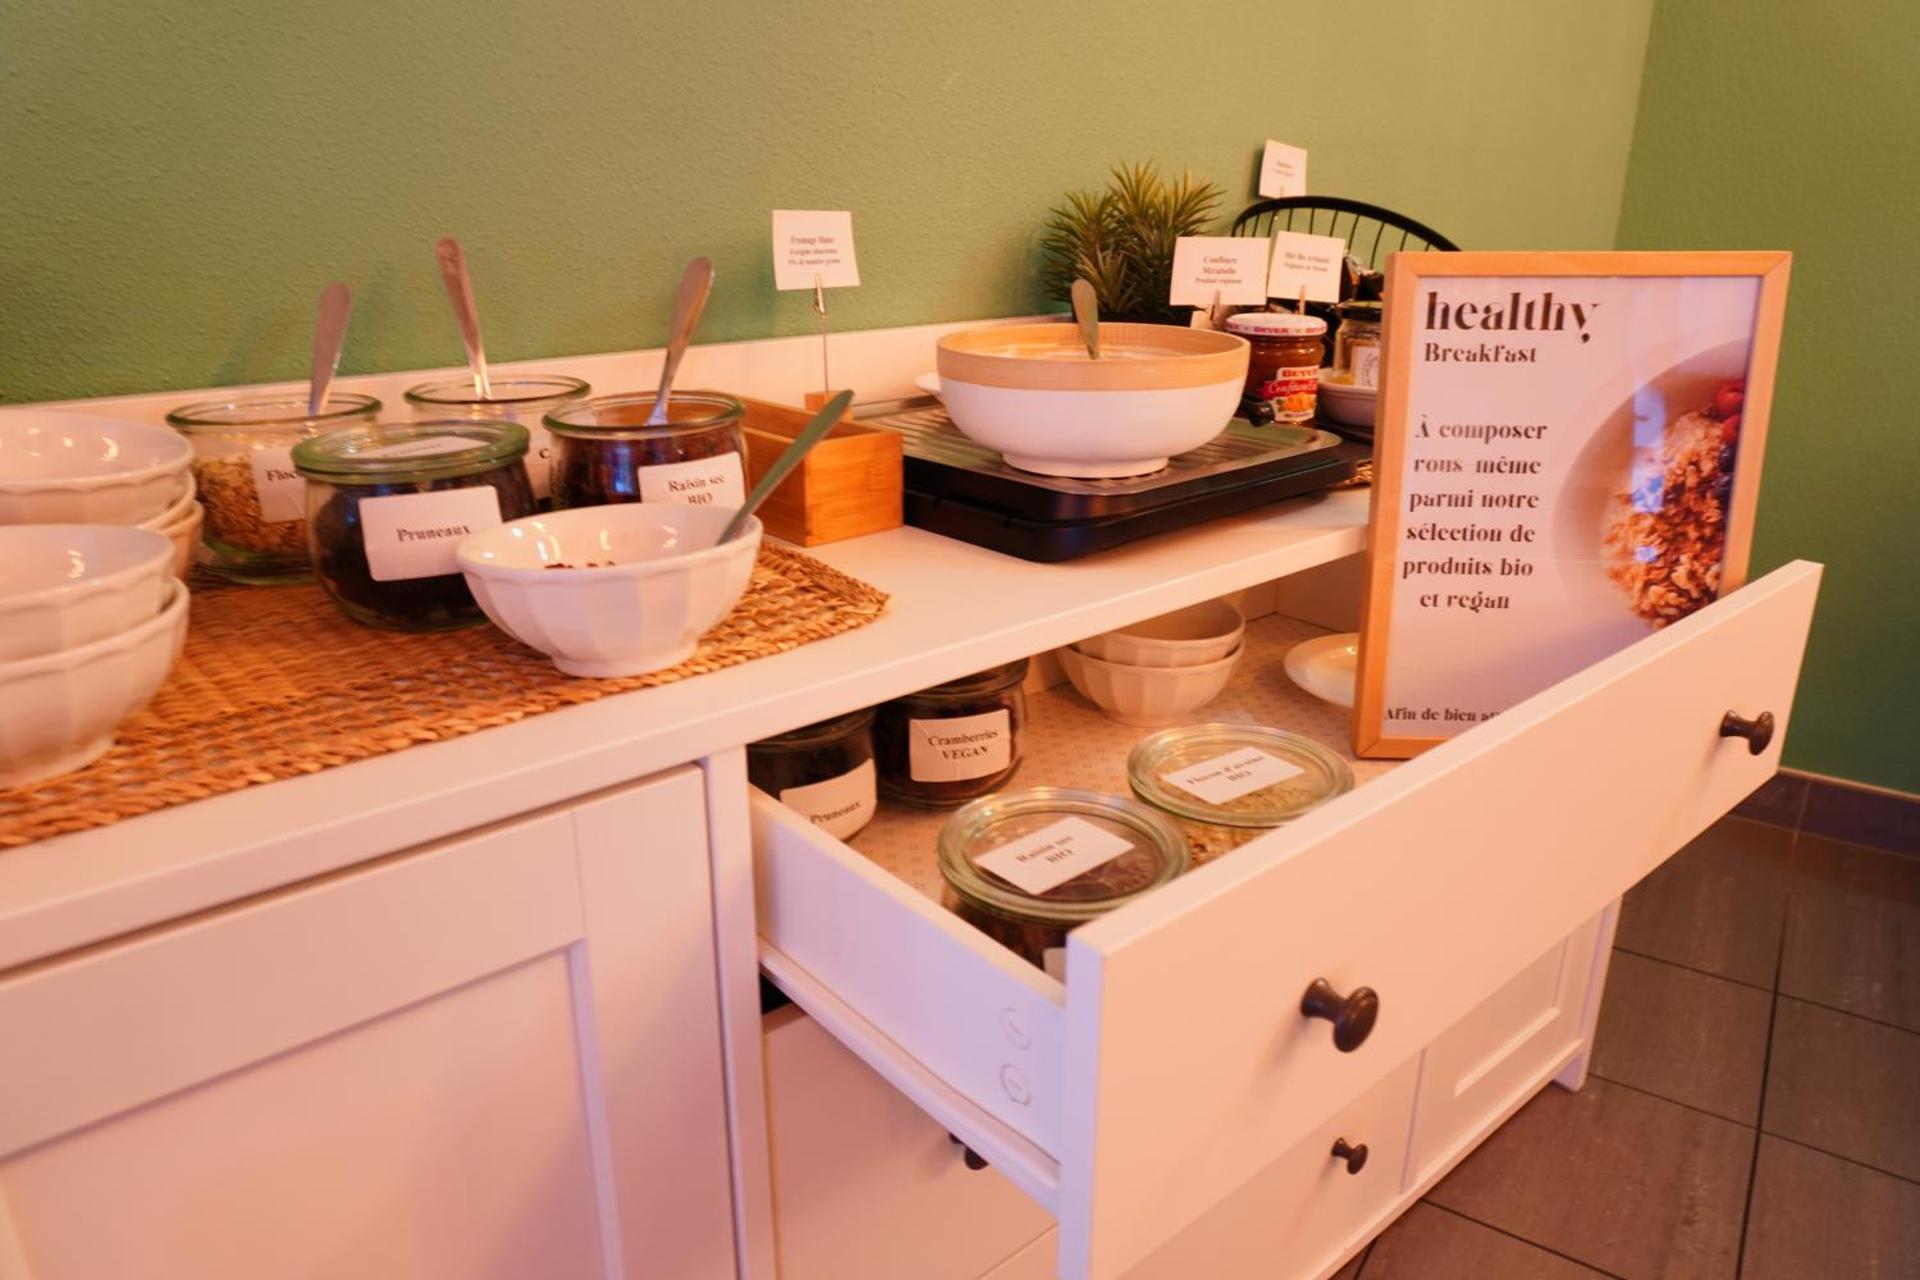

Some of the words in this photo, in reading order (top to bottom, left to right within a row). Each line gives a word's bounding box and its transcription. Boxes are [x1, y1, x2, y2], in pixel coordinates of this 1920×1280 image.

[1425, 291, 1601, 344] healthy
[1424, 342, 1537, 363] Breakfast
[1415, 413, 1430, 439] À
[1438, 423, 1548, 445] composer
[1474, 455, 1542, 475] même
[1409, 488, 1474, 513] parmi
[1481, 492, 1540, 509] notre
[1406, 522, 1502, 542] sélection
[1509, 524, 1536, 543] de
[1402, 556, 1493, 580] produits
[1500, 557, 1534, 576] bio
[1419, 592, 1439, 608] et
[1384, 706, 1417, 721] Afin
[1420, 707, 1440, 721] de
[1444, 707, 1477, 722] bien
